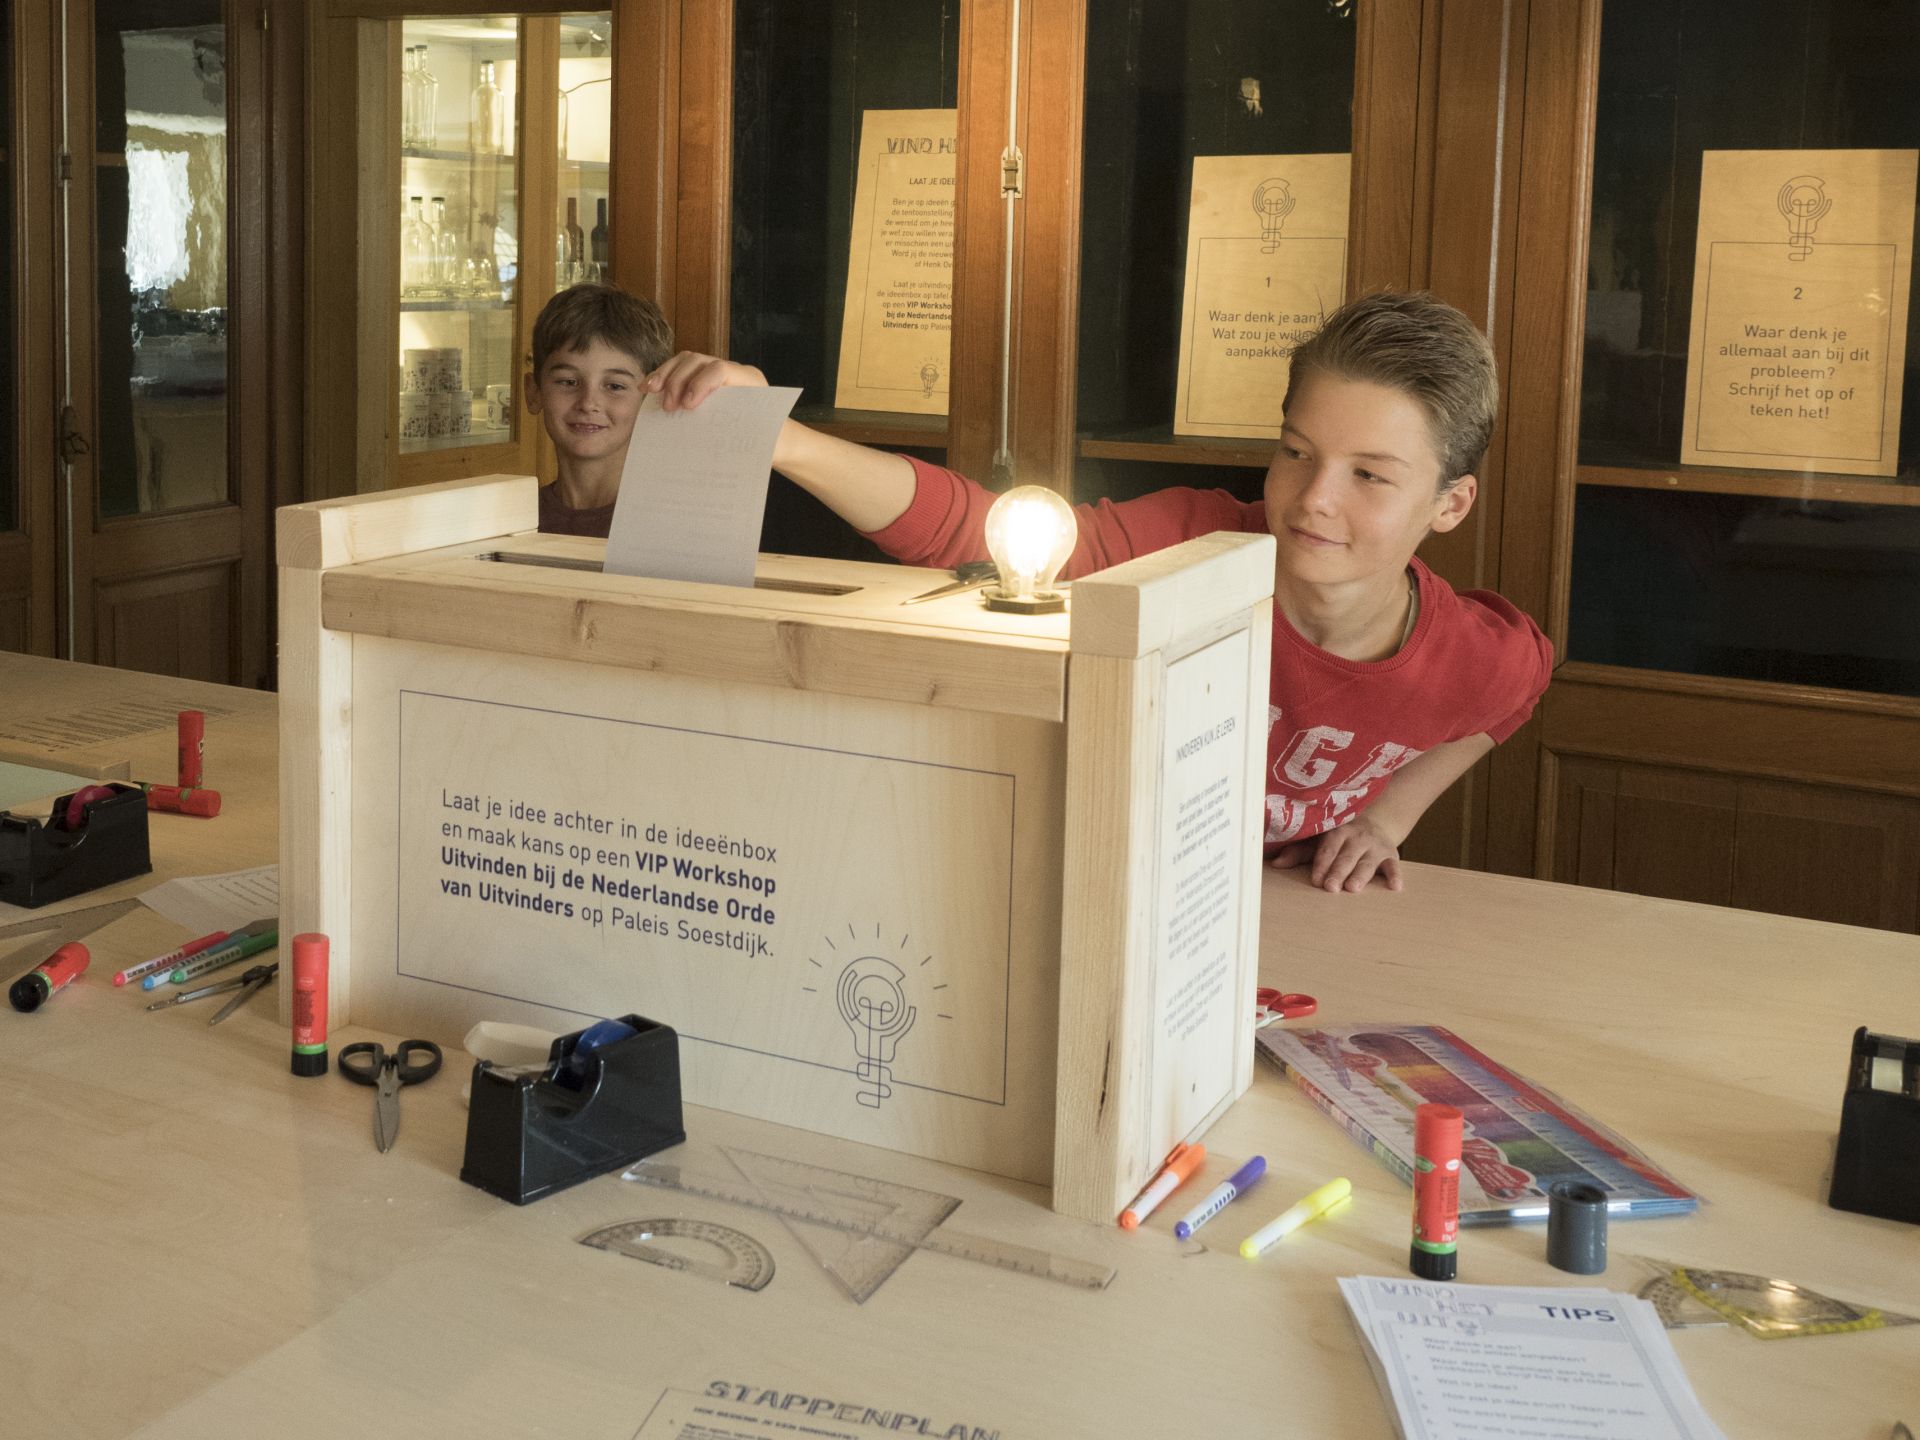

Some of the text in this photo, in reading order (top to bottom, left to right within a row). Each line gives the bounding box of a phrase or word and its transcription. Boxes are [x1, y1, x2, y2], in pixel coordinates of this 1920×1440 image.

[886, 137, 933, 154] VIND
[908, 177, 927, 185] LAAT
[928, 177, 939, 186] JE
[891, 209, 901, 217] de
[885, 218, 894, 227] de
[895, 219, 918, 227] wereld
[932, 220, 939, 229] je
[891, 249, 910, 257] Word
[918, 250, 927, 258] de
[893, 280, 909, 288] Laat
[1265, 276, 1272, 288] 1
[876, 289, 886, 298] de
[923, 292, 932, 300] op
[1793, 286, 1804, 300] 2
[882, 301, 892, 309] op
[906, 301, 919, 309] VIP
[886, 310, 896, 320] bij
[896, 311, 905, 319] de
[1209, 310, 1325, 326] Waar denk je aan?
[882, 320, 919, 330] Uitvinders
[1212, 327, 1236, 340] Wat
[1239, 330, 1261, 341] zou
[1264, 329, 1276, 343] je
[1744, 324, 1847, 343] Waar denk je
[1719, 343, 1870, 364] allemaal aan bij dit
[1750, 364, 1836, 380] probleem?
[1728, 381, 1855, 403] Schrijf het op of
[1750, 404, 1830, 420] teken het!
[442, 788, 777, 863] Laat je idee achter in de ideeënbox
[442, 821, 777, 898] en maak kans op een VIP Workshop
[441, 846, 777, 925] Uitvinden bij de Nederlandse Orde
[440, 877, 776, 959] van Uitvinders op Paleis Soestdijk.
[1539, 1303, 1616, 1323] TIPS
